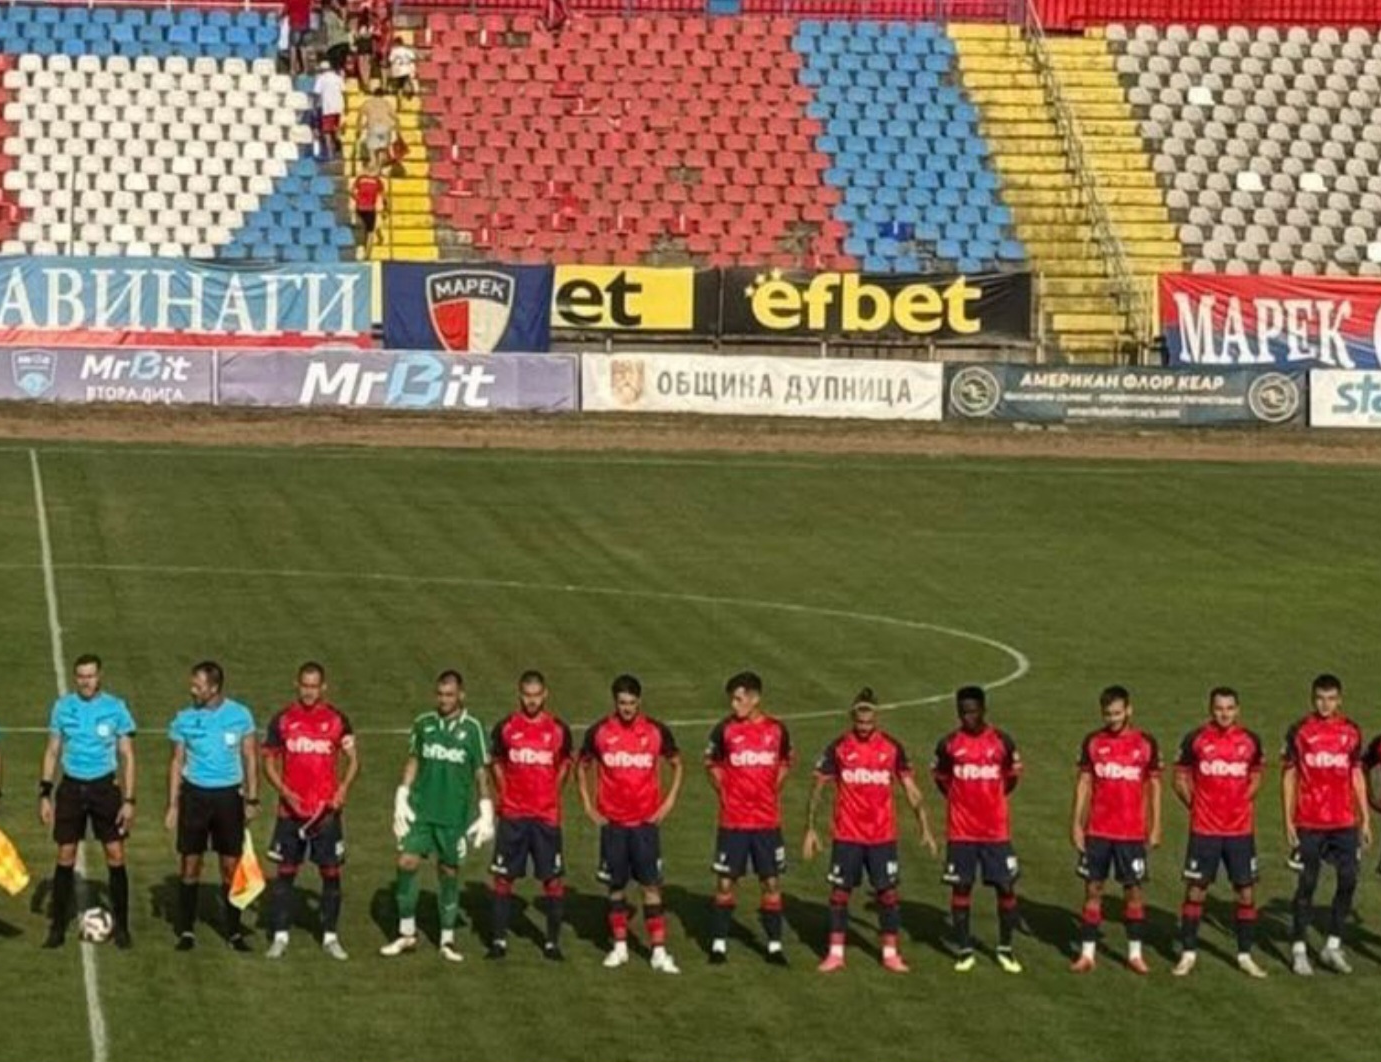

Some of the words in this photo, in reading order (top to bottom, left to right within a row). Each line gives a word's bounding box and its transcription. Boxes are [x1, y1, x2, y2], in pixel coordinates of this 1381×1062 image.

[434, 277, 508, 300] МАРЕК
[746, 268, 982, 333] efbet
[1172, 291, 1356, 368] МАРЕК
[80, 351, 192, 381] MrBit
[299, 353, 495, 408] MrBit
[1019, 372, 1119, 389] АМЕРИКАН
[656, 371, 773, 398] ОБЩИНА
[784, 375, 912, 407] ДУПНИЦА
